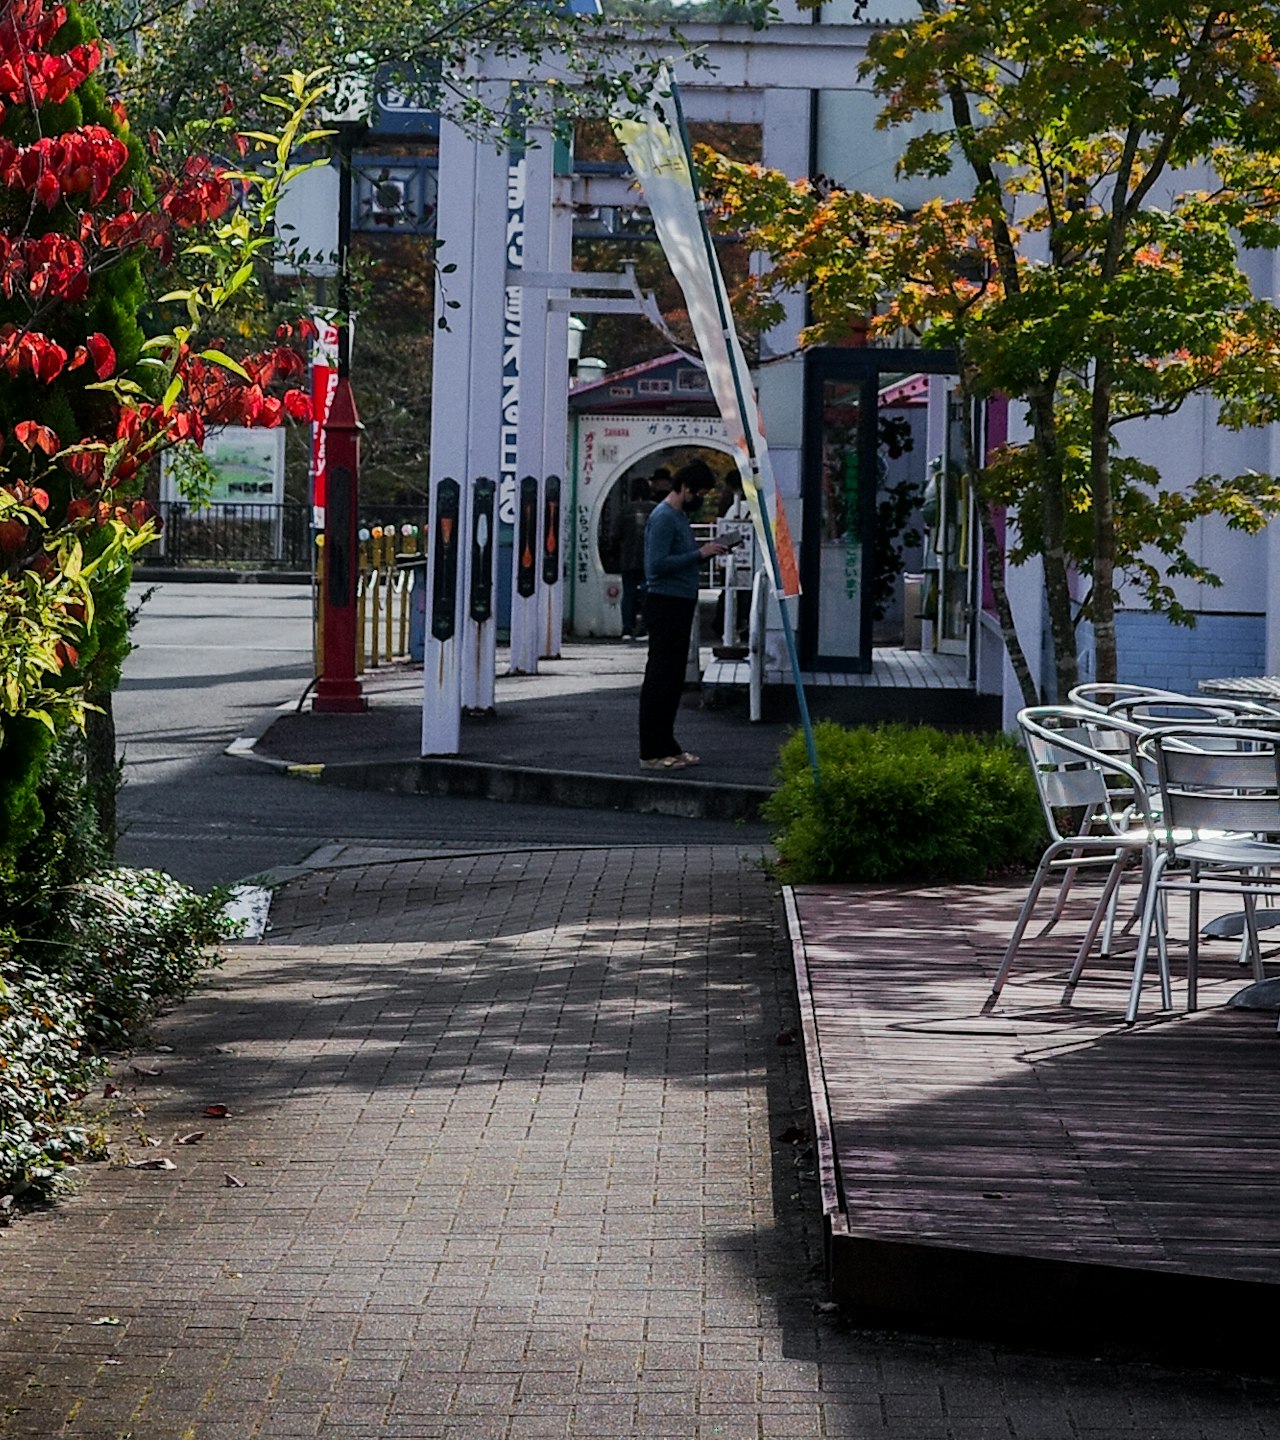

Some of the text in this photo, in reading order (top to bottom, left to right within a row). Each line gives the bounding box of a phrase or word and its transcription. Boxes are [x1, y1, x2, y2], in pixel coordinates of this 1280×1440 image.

[578, 504, 588, 583] いらっしゃいませ
